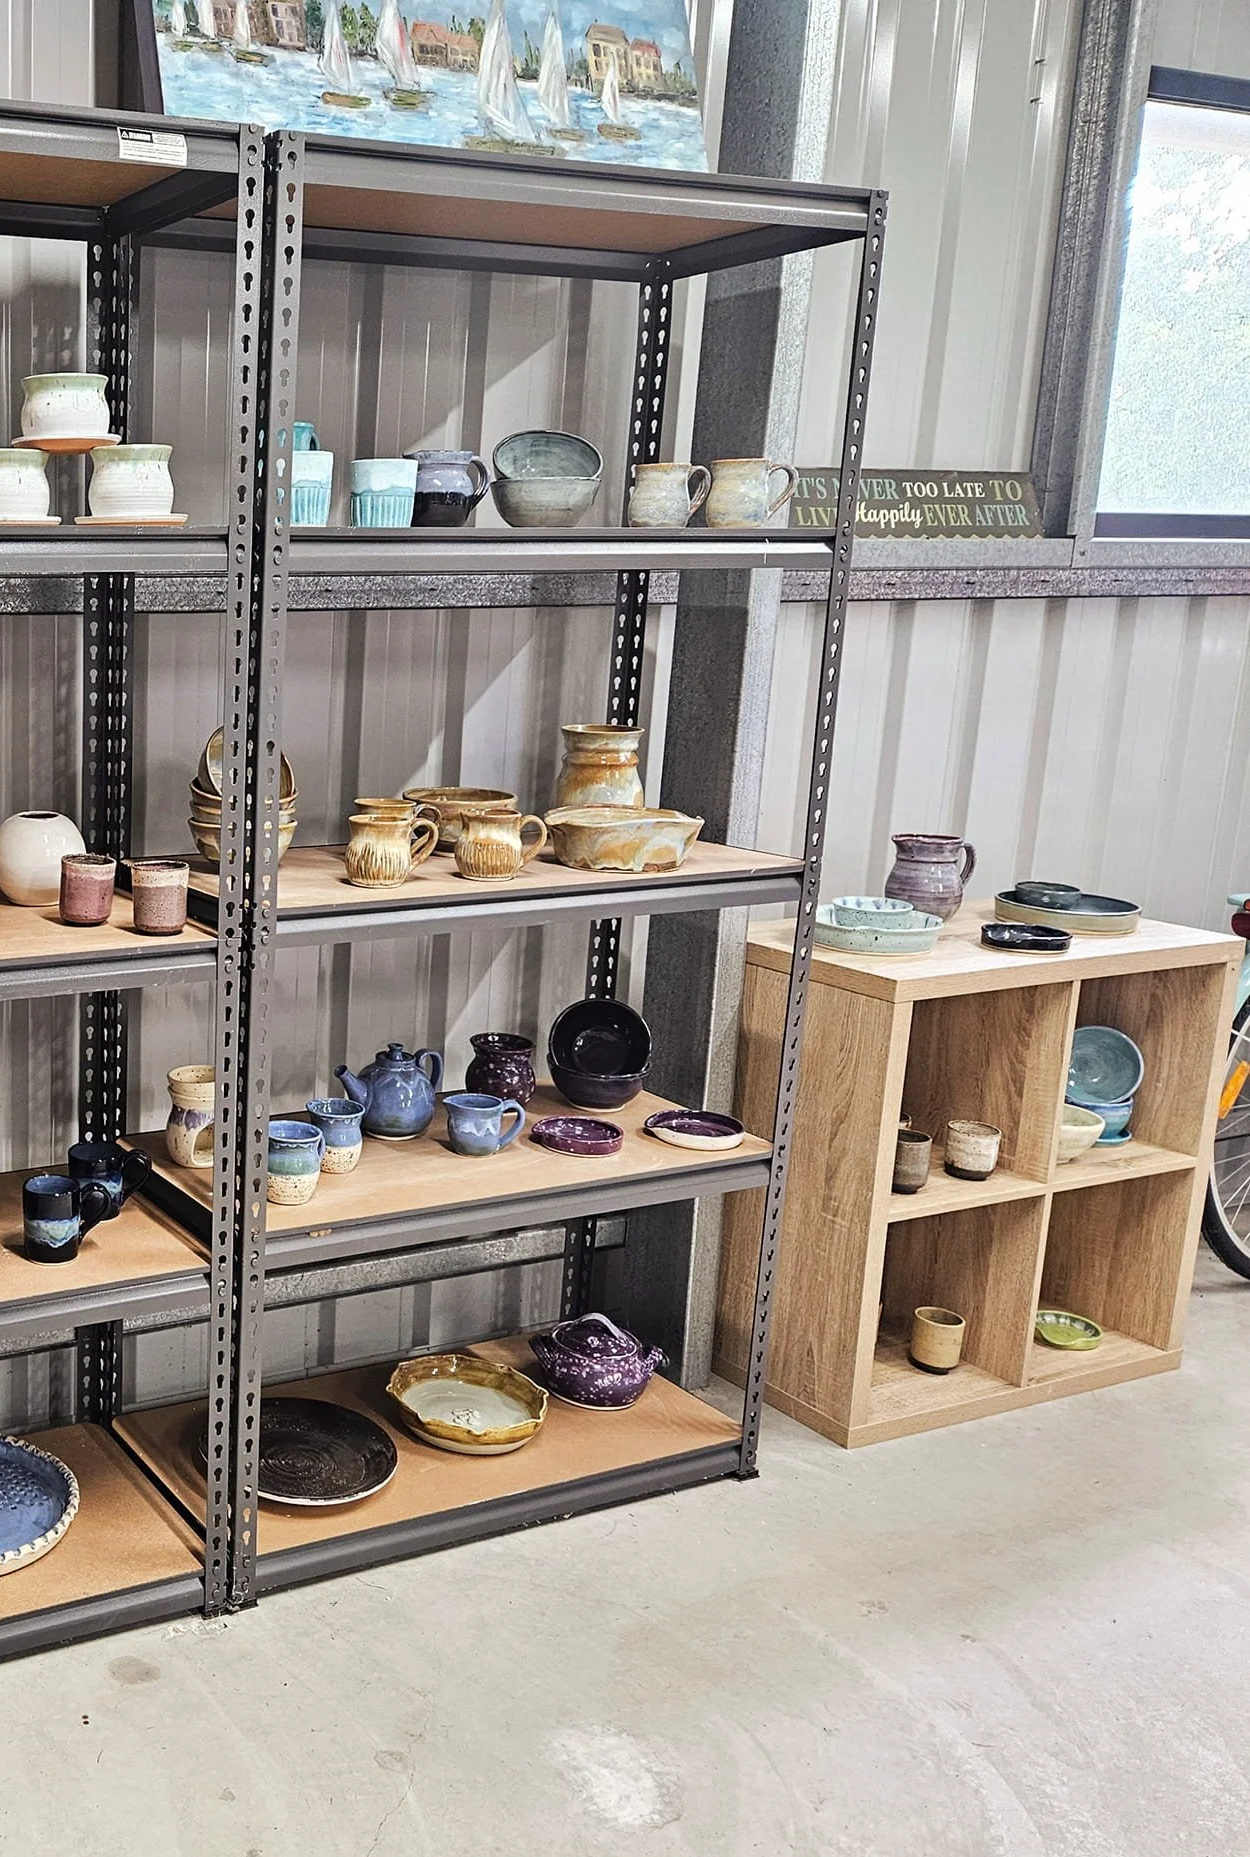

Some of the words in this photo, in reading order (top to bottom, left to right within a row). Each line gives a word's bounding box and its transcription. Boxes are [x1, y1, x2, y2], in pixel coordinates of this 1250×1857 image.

[902, 481, 938, 498] TOO
[942, 482, 985, 498] LATE
[989, 480, 1023, 501] TO
[795, 506, 837, 526] LIV
[855, 501, 923, 529] Happily
[922, 504, 972, 526] EVER
[975, 504, 1030, 526] AFTER
